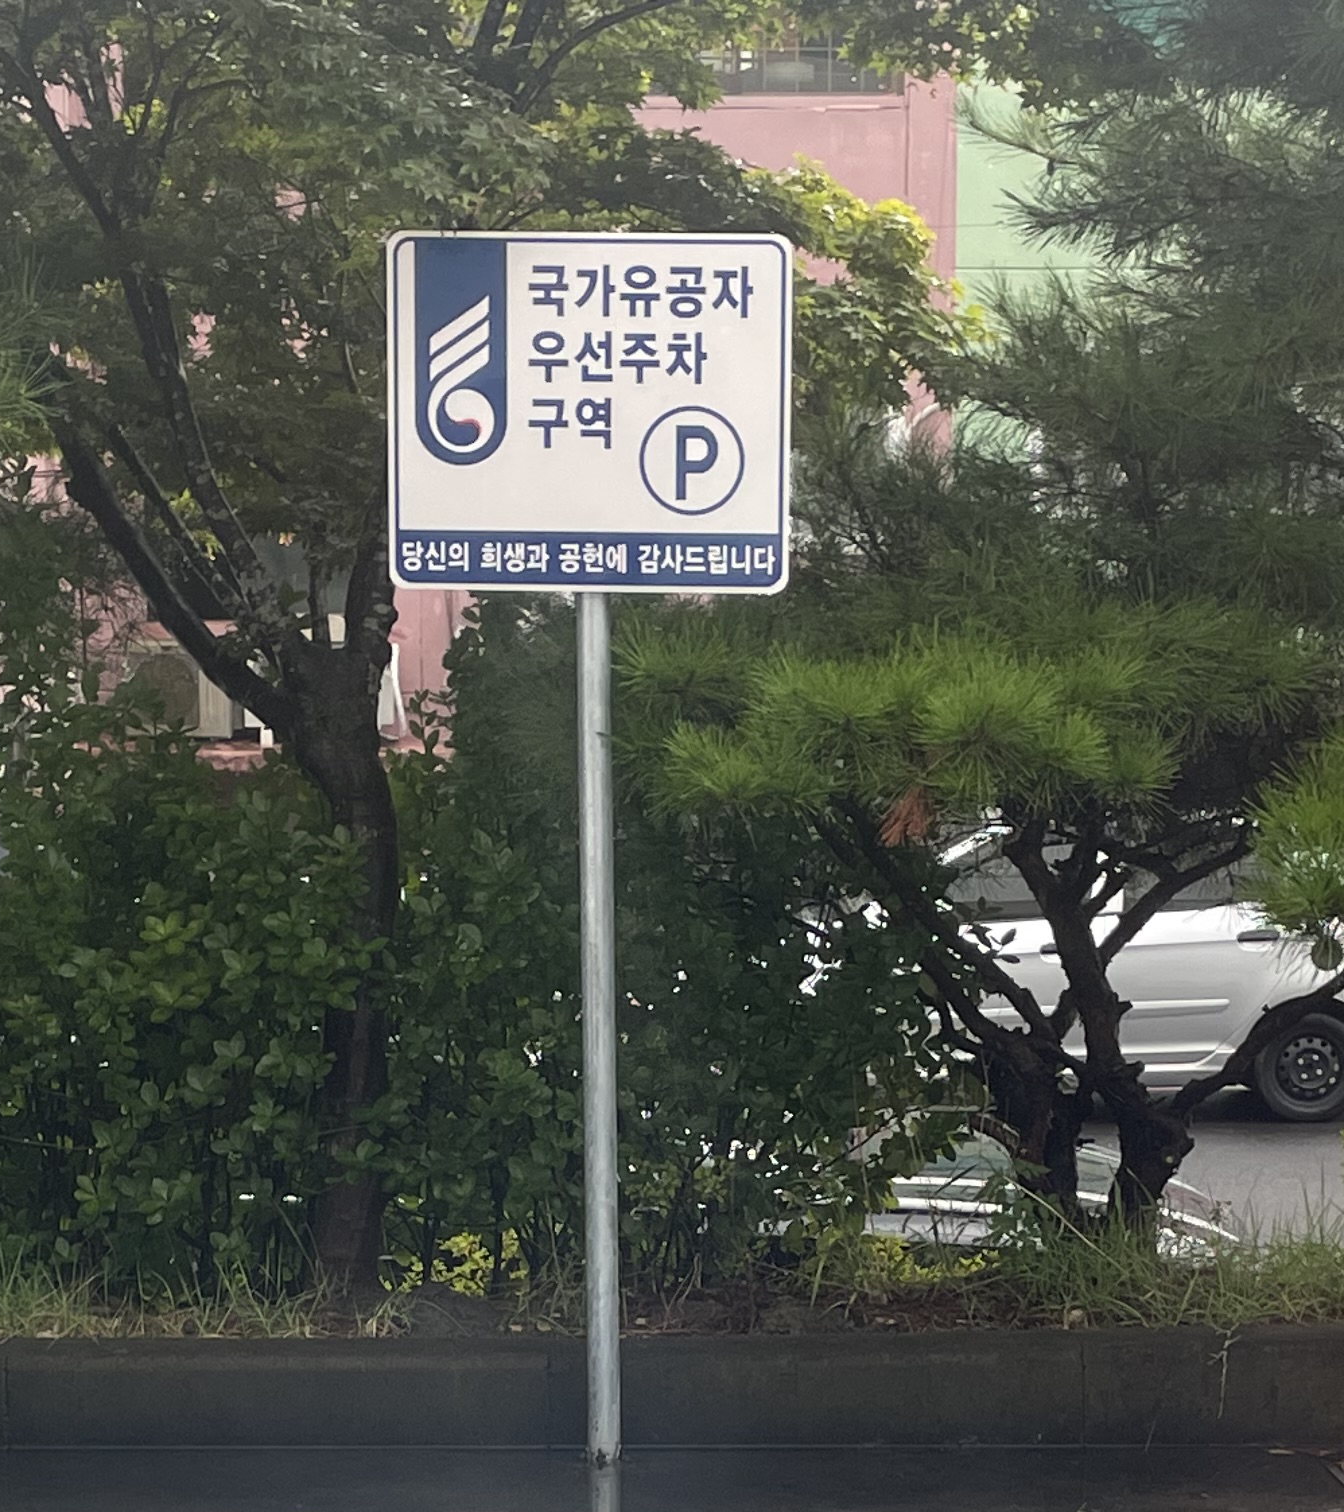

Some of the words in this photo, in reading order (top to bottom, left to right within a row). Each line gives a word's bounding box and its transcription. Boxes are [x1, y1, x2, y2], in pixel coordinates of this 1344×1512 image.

[528, 265, 754, 318] 국가유공자
[528, 330, 708, 384] 우선주차
[528, 398, 612, 449] 구역
[675, 425, 719, 501] P
[401, 540, 470, 572] 당신의
[480, 541, 549, 574] 희생과
[558, 542, 627, 575] 공헌에
[637, 543, 775, 576] 감사드립니다
